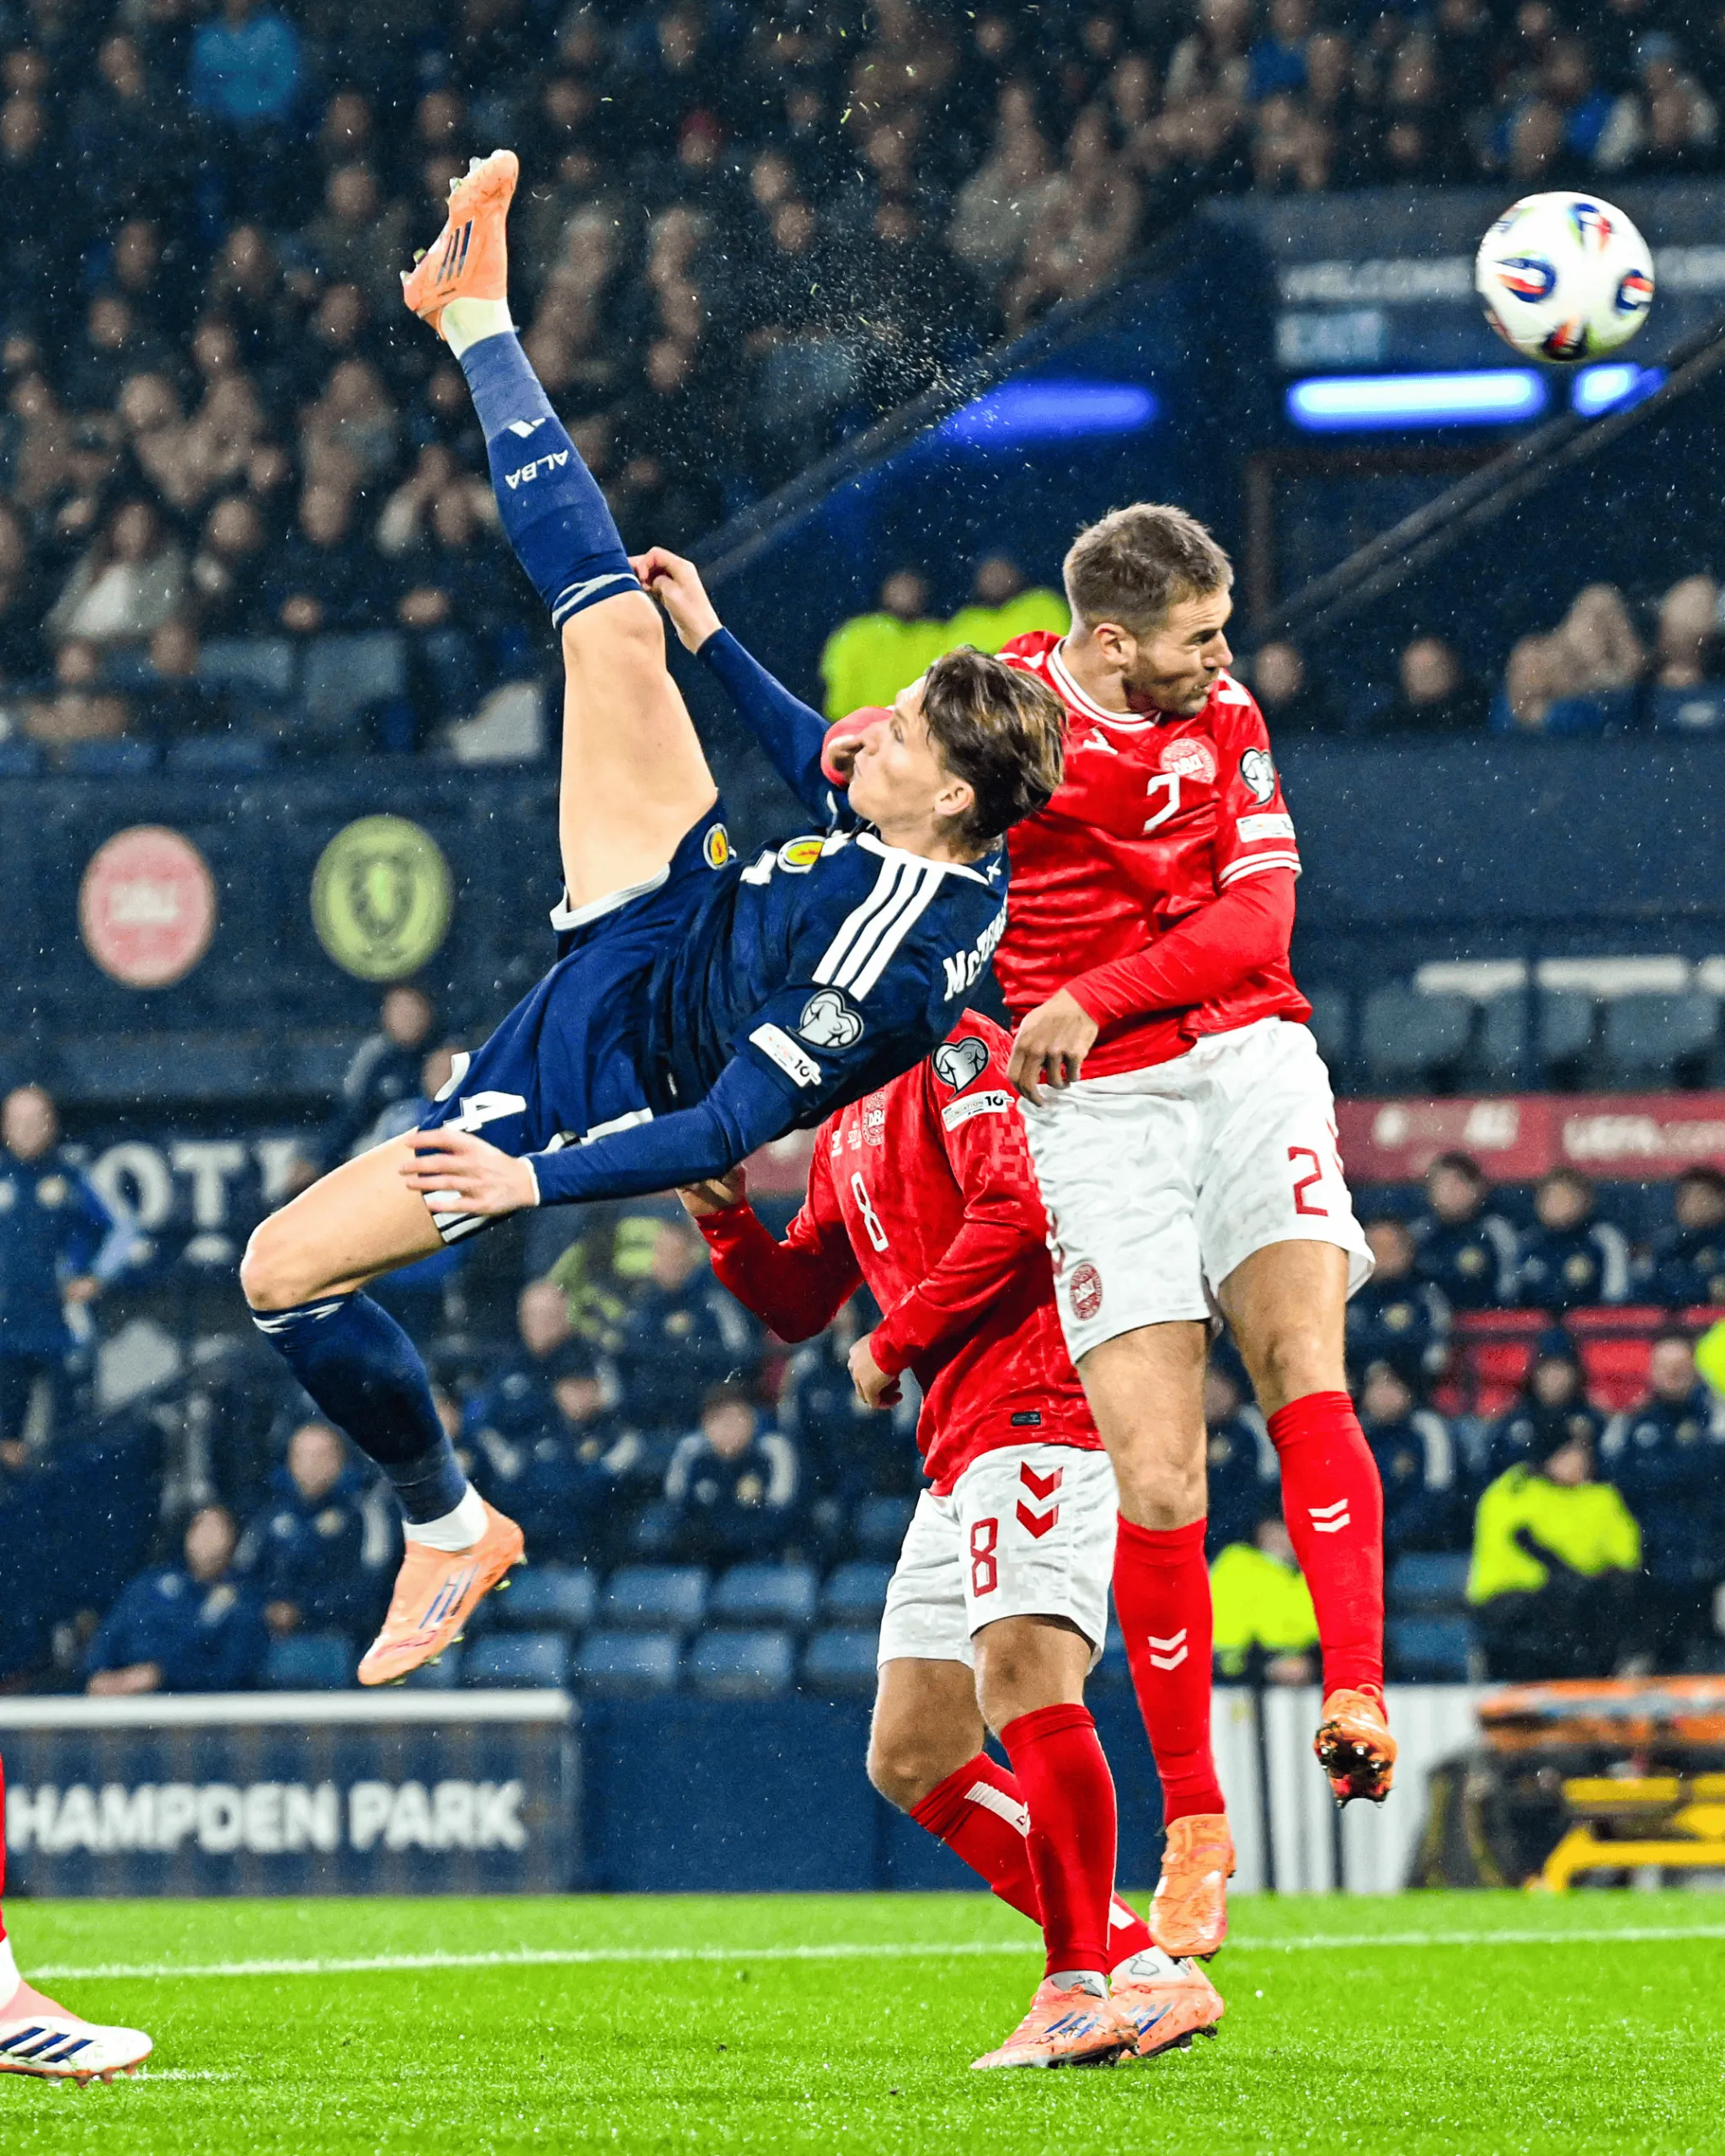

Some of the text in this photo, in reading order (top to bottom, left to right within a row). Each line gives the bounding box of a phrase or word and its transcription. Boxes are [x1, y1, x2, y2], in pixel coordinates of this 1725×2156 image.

[505, 449, 569, 489] ALBA
[442, 1090, 527, 1132] 4
[851, 1171, 889, 1252] 8
[1287, 1145, 1329, 1218] 2
[970, 1517, 999, 1598] 8
[5, 1780, 526, 1852] HAMPDEN PARK
